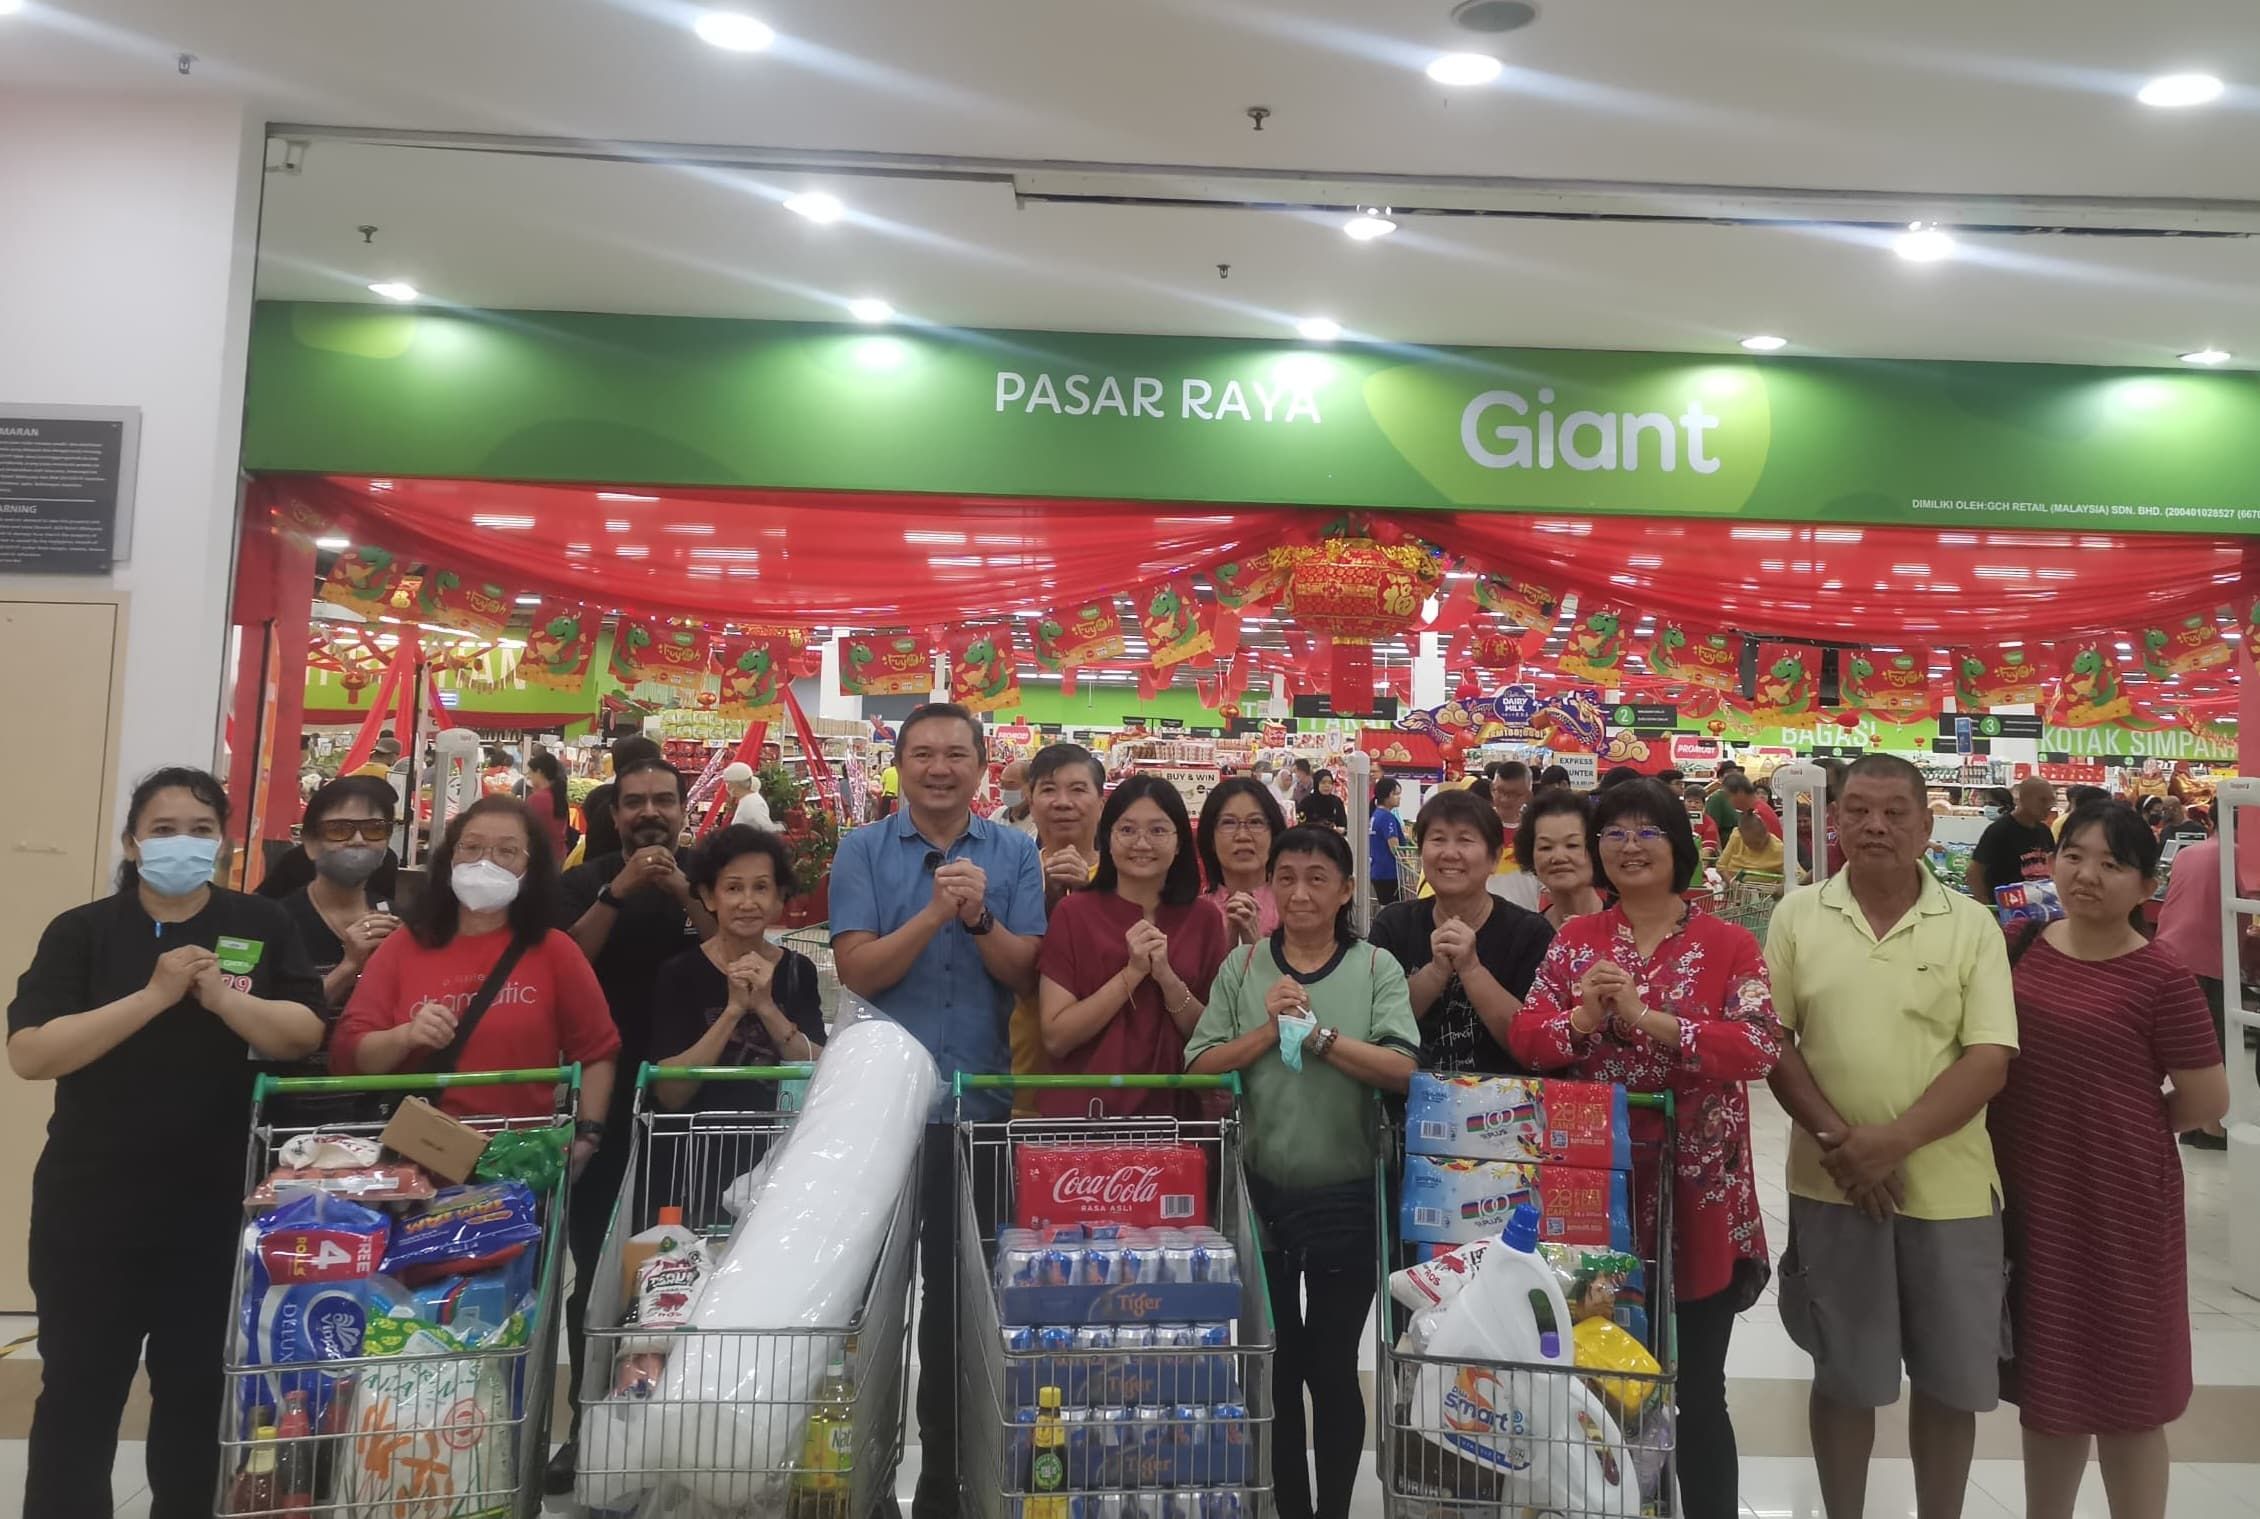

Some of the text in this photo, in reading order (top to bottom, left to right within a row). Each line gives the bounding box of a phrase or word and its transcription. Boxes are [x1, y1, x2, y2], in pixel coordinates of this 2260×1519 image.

[995, 371, 1322, 425] PASAR RAYA
[1460, 387, 1722, 475] Giant
[1912, 499, 1954, 510] DIMILIKI
[2012, 501, 2049, 513] RETAIL
[2050, 502, 2110, 515] (MALAYSIA)
[2111, 504, 2136, 515] SDN.
[2137, 505, 2163, 517] BHD.
[1502, 697, 1529, 706] DAIRY
[1505, 704, 1525, 712] MILK
[1620, 708, 1629, 723] 2
[1986, 719, 1994, 733] 3
[2040, 727, 2121, 755] KOTAK
[1559, 757, 1593, 765] EXPRESS
[1166, 773, 1215, 782] BUY & WIN
[1569, 769, 1594, 777] UNTER
[1484, 1108, 1516, 1130] 100
[1080, 1204, 1133, 1213] RASA ASLI
[1478, 1194, 1510, 1217] 100
[310, 1240, 352, 1270] 4
[355, 1236, 373, 1273] FREE
[1424, 1269, 1441, 1287] ROS
[1116, 1294, 1162, 1318] Tiger
[279, 1302, 297, 1363] DELUX
[1108, 1375, 1154, 1399] Tiger
[1126, 1455, 1172, 1478] Tiger
